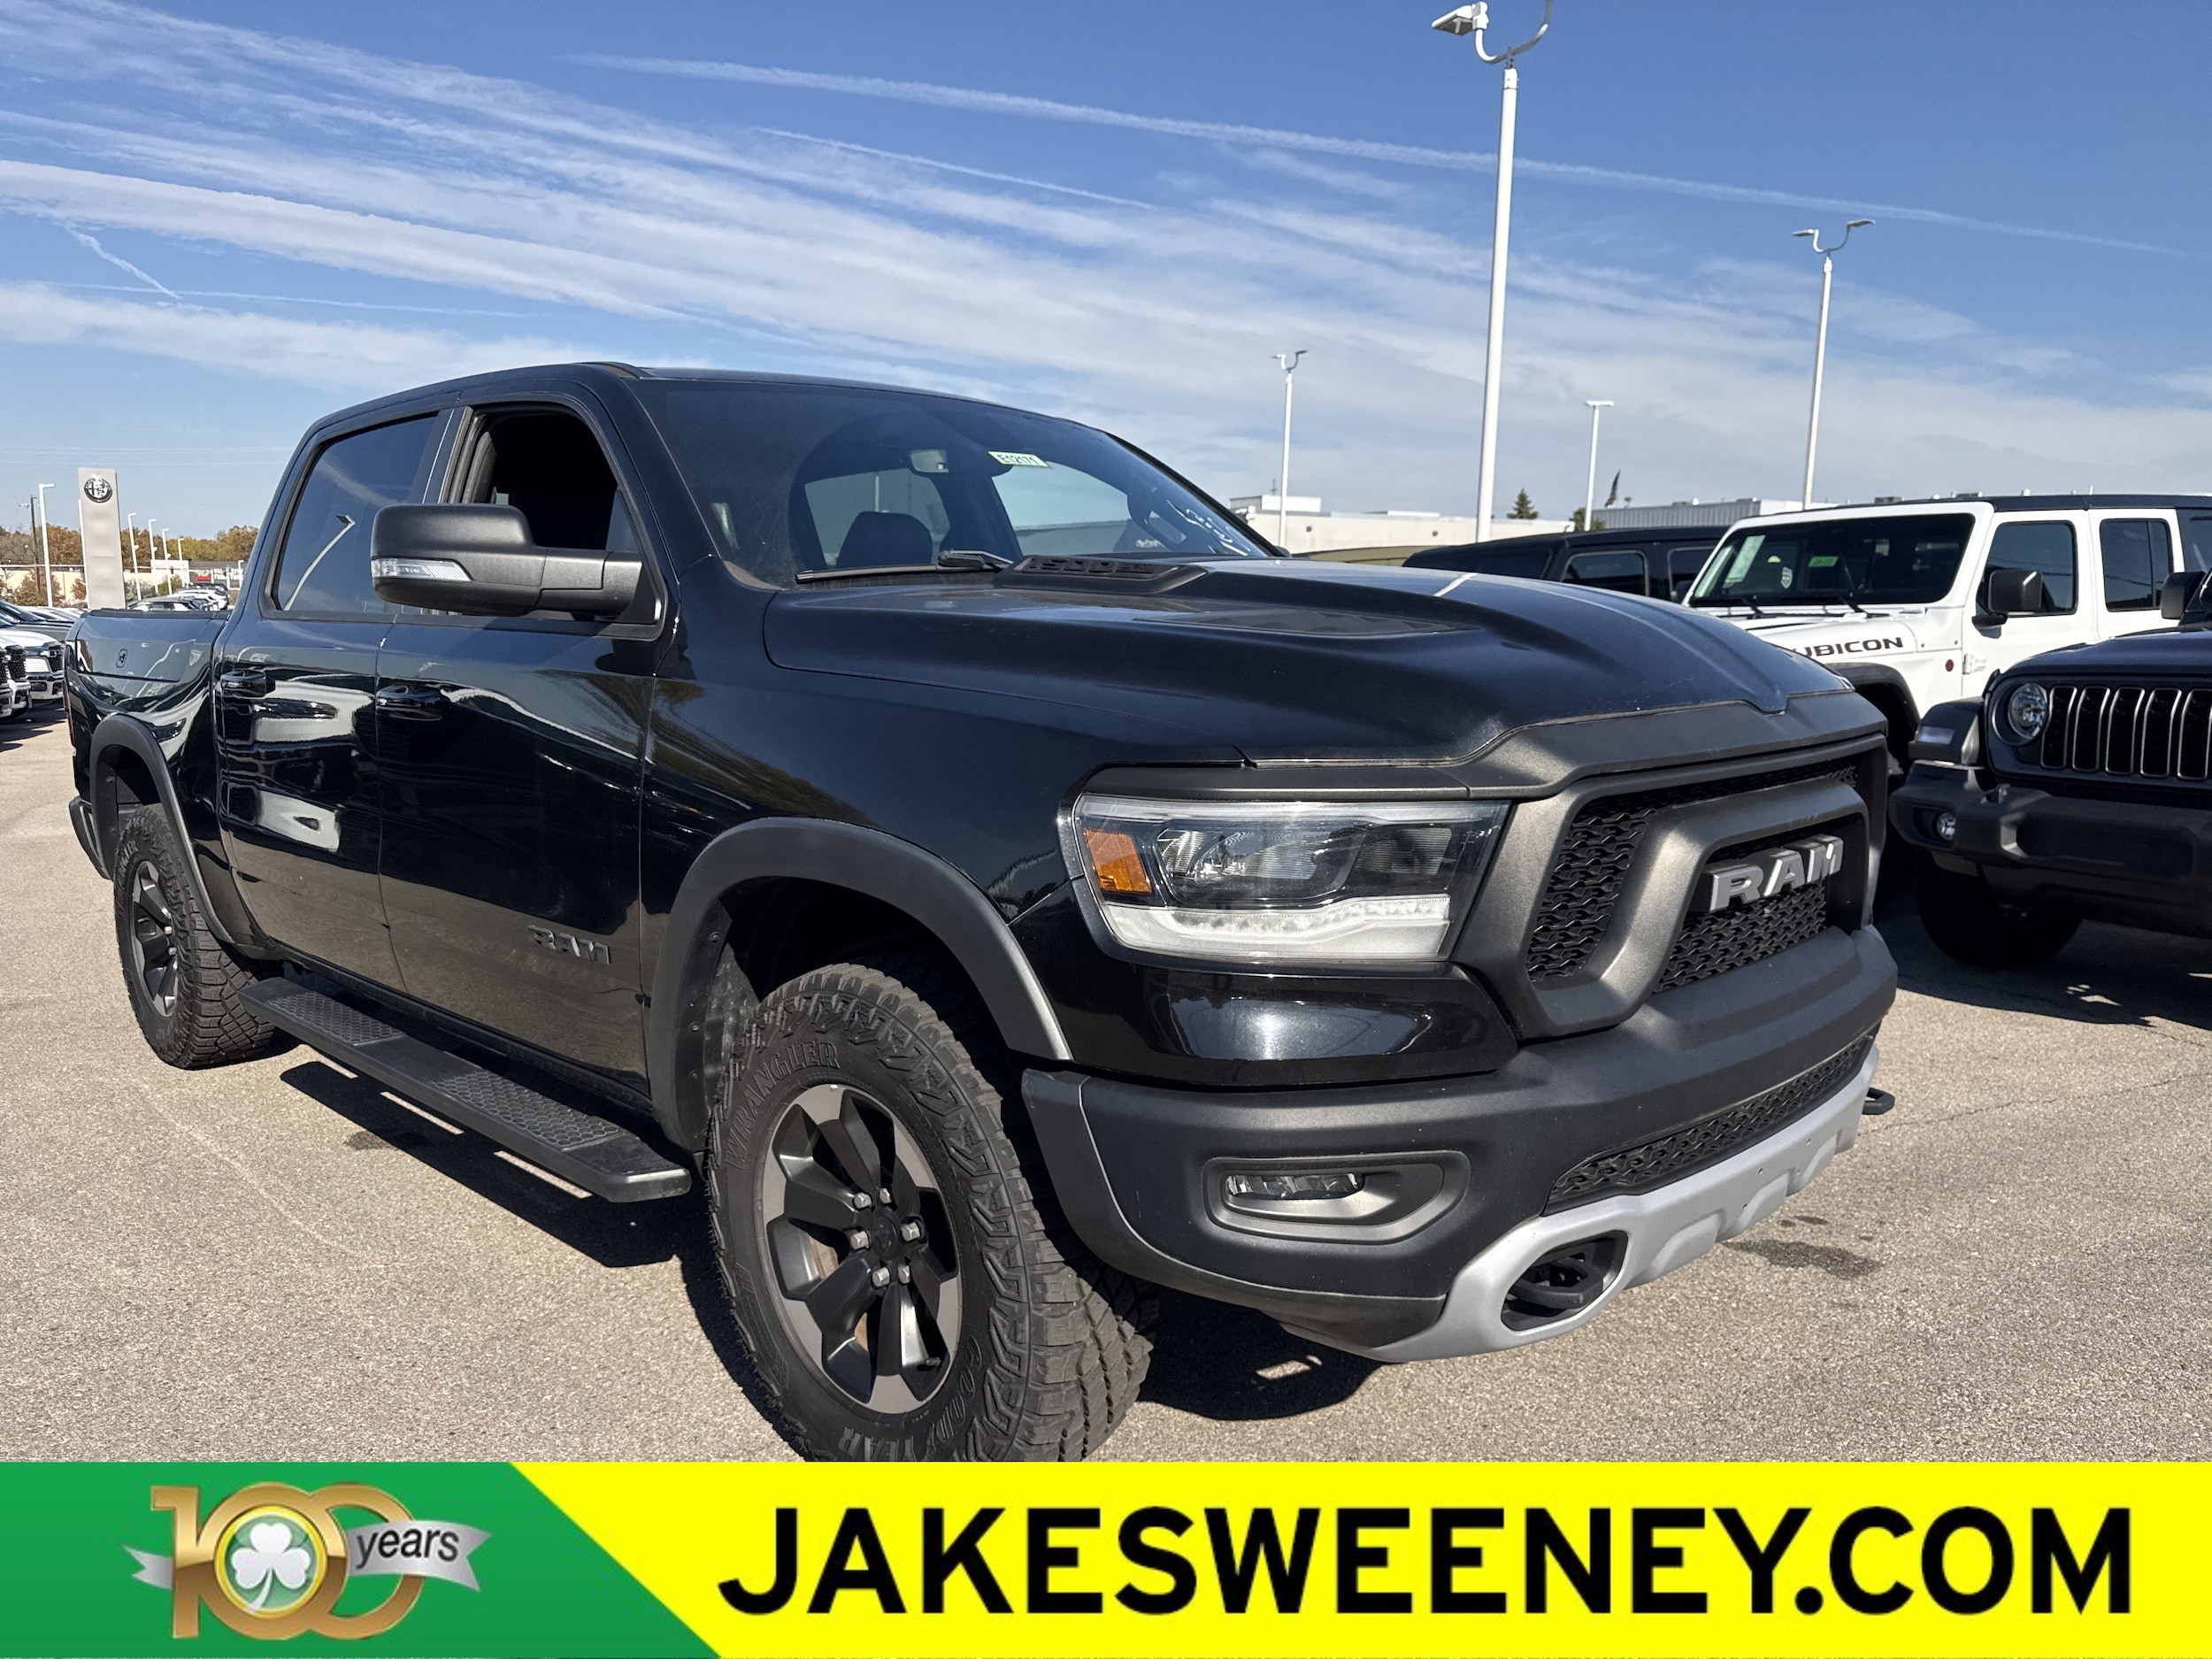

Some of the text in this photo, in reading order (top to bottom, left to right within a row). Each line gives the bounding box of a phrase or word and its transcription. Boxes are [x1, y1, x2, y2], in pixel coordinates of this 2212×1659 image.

[1709, 834, 1845, 912] RAM
[527, 925, 611, 965] RAM
[725, 1040, 841, 1170] WRANGLER
